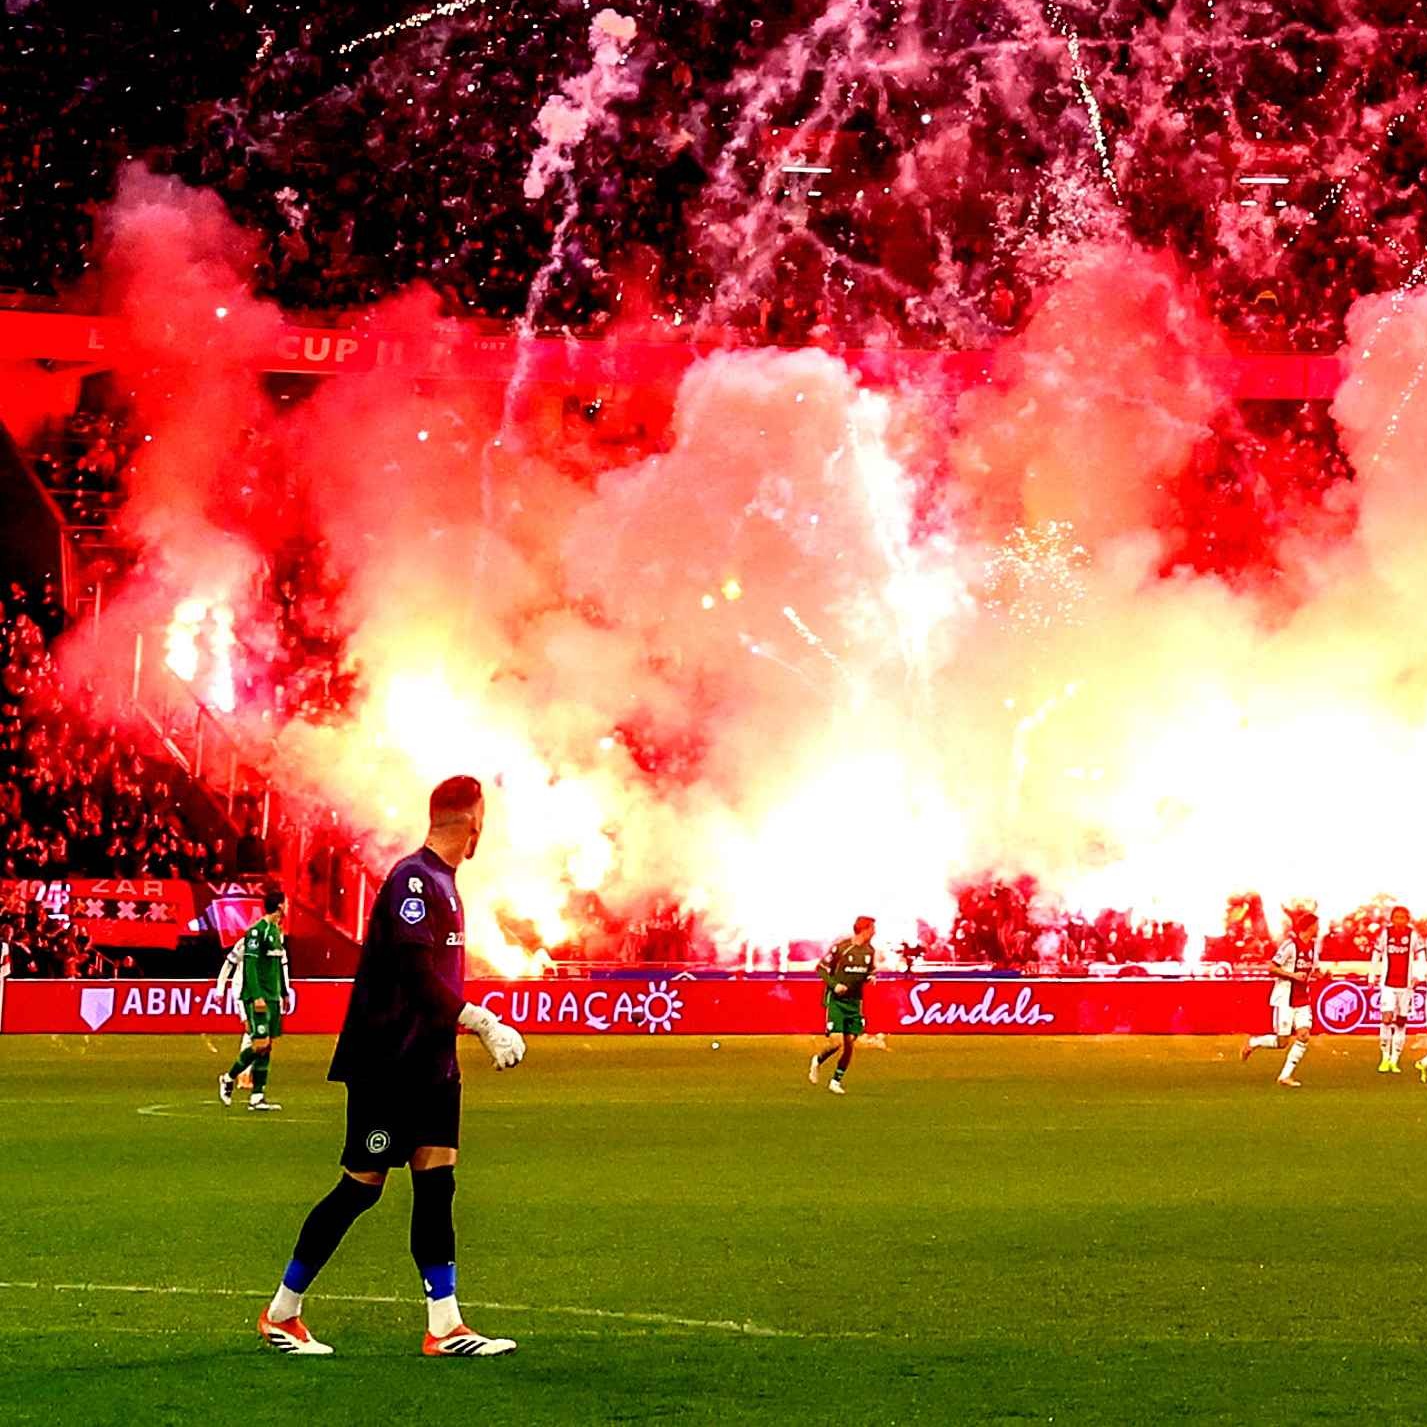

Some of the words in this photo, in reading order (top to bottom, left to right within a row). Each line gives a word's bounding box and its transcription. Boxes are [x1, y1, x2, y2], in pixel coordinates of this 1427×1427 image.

[276, 334, 359, 362] CUP
[207, 881, 266, 896] VAK
[900, 981, 1055, 1025] Sandals
